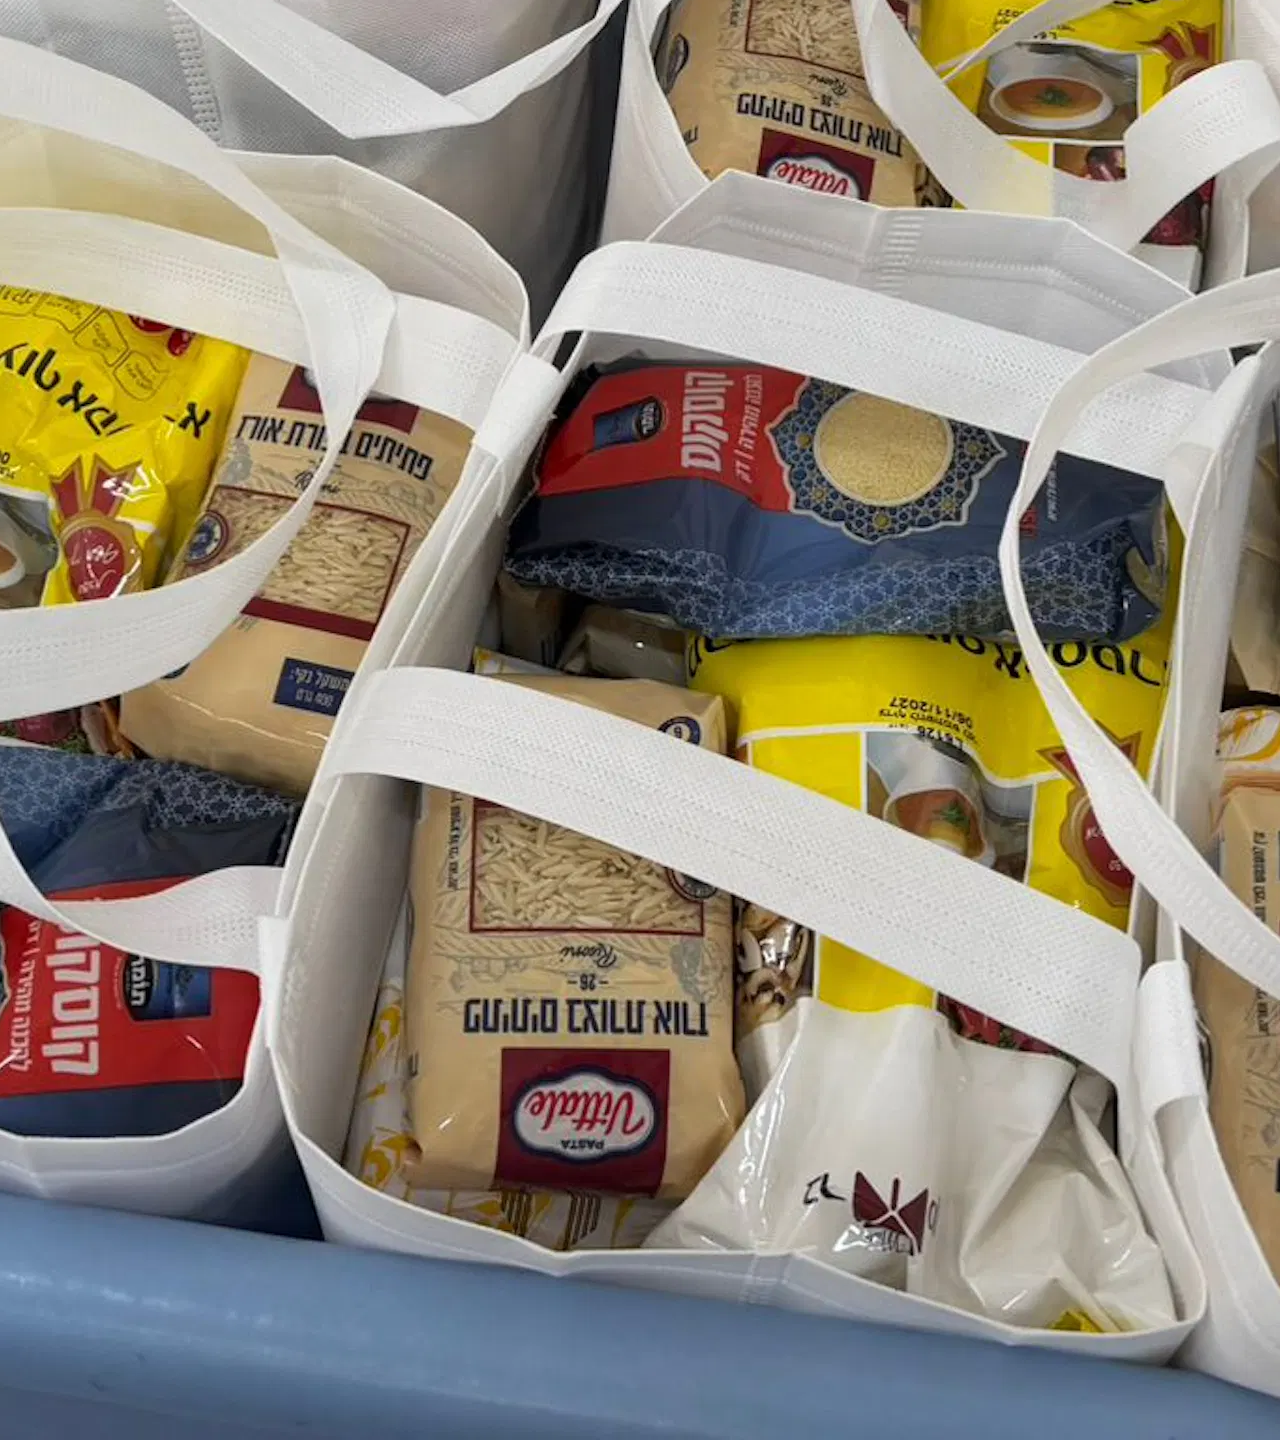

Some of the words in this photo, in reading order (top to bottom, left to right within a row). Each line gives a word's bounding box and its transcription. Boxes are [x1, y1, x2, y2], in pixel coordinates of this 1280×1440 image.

[737, 93, 805, 126] פתיתים
[809, 109, 862, 141] בצורת
[866, 125, 903, 158] אורז
[234, 414, 285, 442] אורז
[680, 371, 734, 472] קוסקוס
[352, 432, 433, 481] פתיתים
[41, 920, 102, 1076] קוסקו
[579, 972, 596, 992] 26
[462, 996, 559, 1035] פתיתים
[564, 998, 646, 1037] בצורת
[652, 999, 710, 1040] אורז
[524, 1087, 646, 1137] Vittale
[560, 1137, 605, 1152] PASTA
